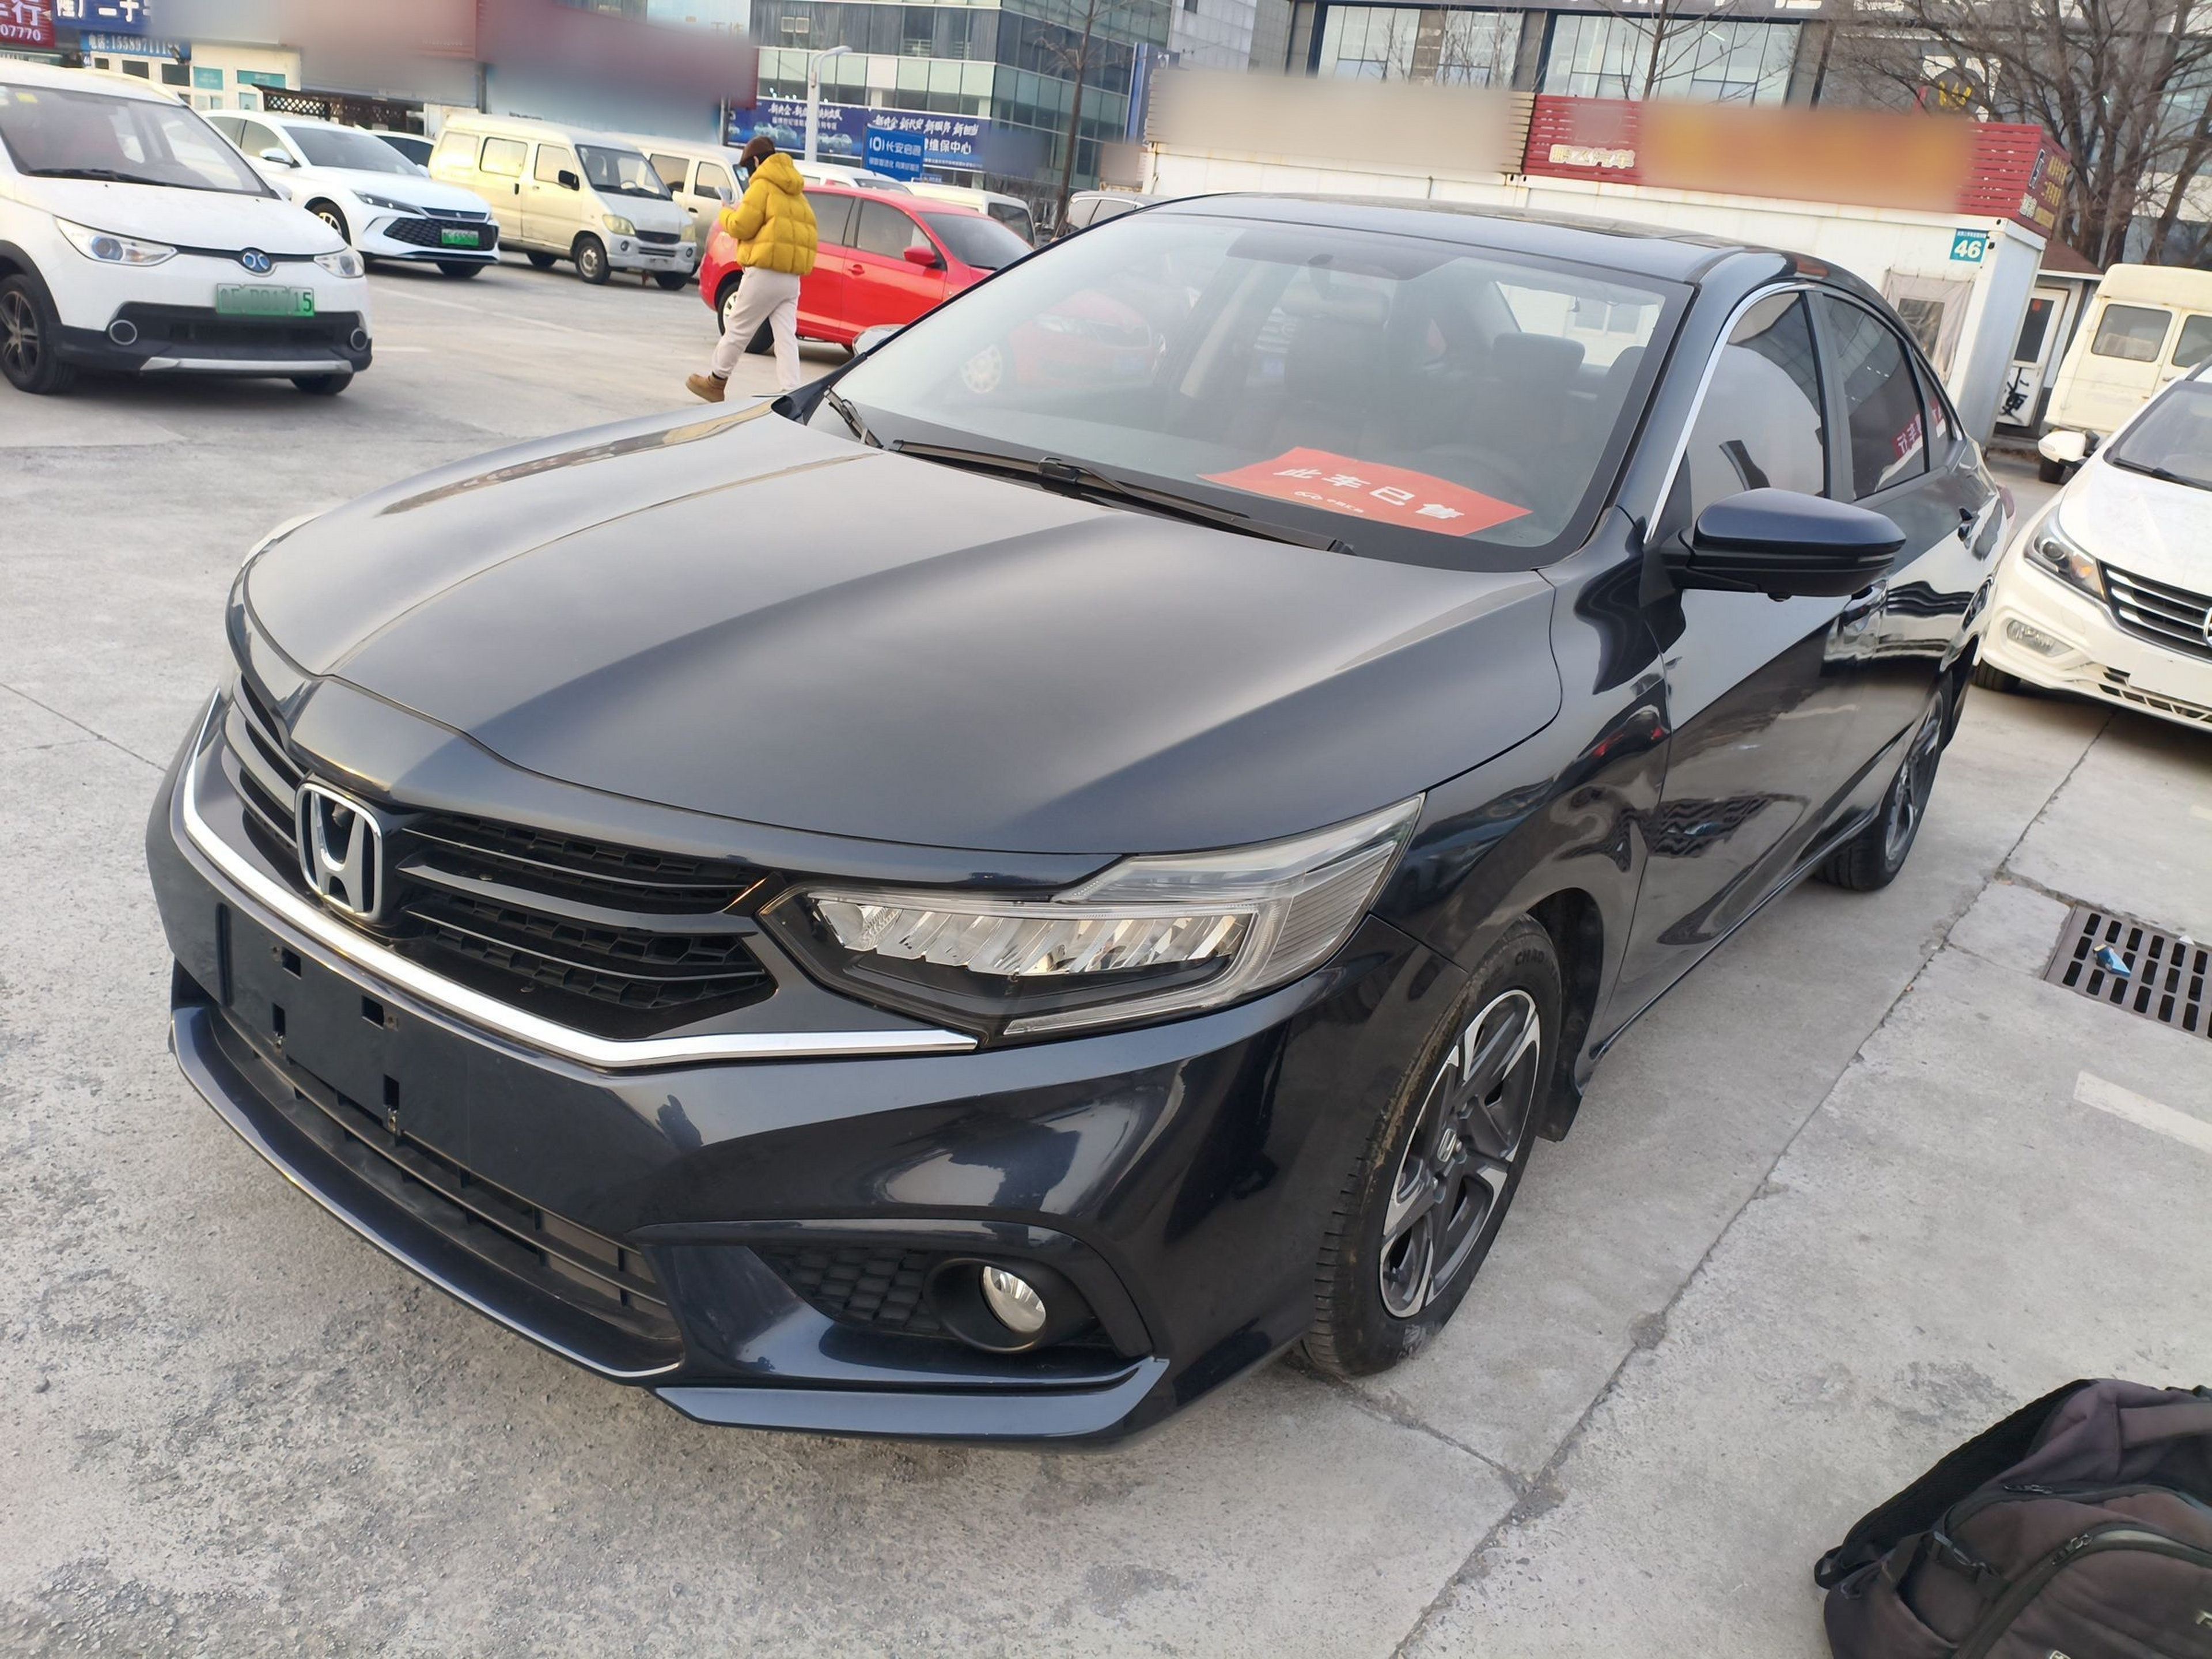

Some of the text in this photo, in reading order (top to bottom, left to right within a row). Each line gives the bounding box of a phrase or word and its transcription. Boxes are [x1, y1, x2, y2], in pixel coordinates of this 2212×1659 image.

[924, 137, 972, 155] 维保中心
[1954, 240, 1982, 259] 46
[1273, 467, 1465, 519] 此车已售
